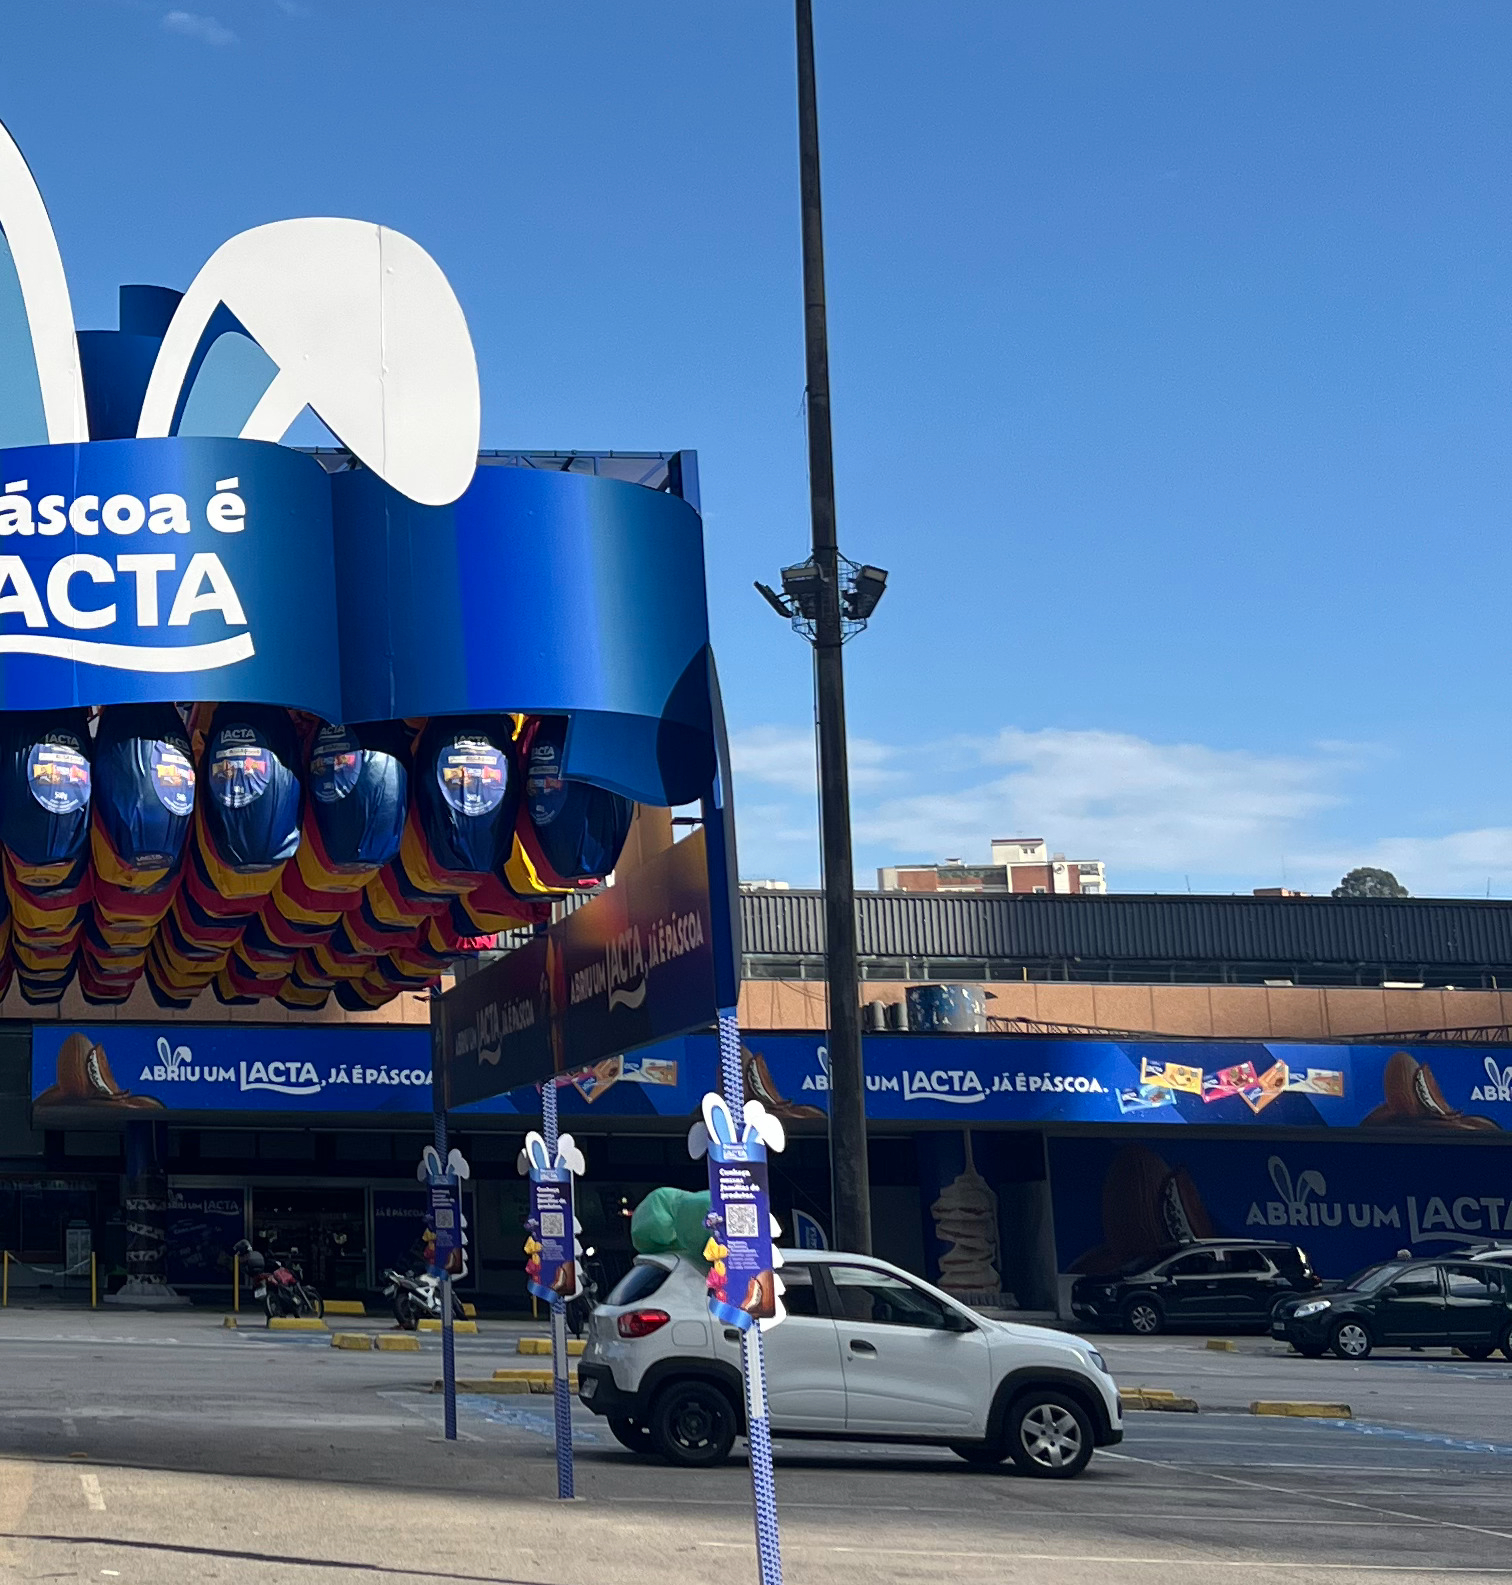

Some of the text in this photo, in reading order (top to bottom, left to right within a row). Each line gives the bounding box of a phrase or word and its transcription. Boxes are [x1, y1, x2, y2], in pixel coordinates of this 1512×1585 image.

[206, 476, 246, 533] é
[45, 733, 80, 751] LACTA
[221, 728, 256, 744] LACTA
[319, 725, 347, 740] ACTA
[139, 1065, 201, 1082] ABRIU
[203, 1066, 236, 1082] UM
[240, 1060, 326, 1096] LACTA,
[327, 1064, 350, 1084] JÁ
[351, 1064, 364, 1084] É
[866, 1070, 1109, 1104] UM LACTA, JÁ É PÁSCOA.
[1246, 1196, 1512, 1244] ABRIU UM LACT
